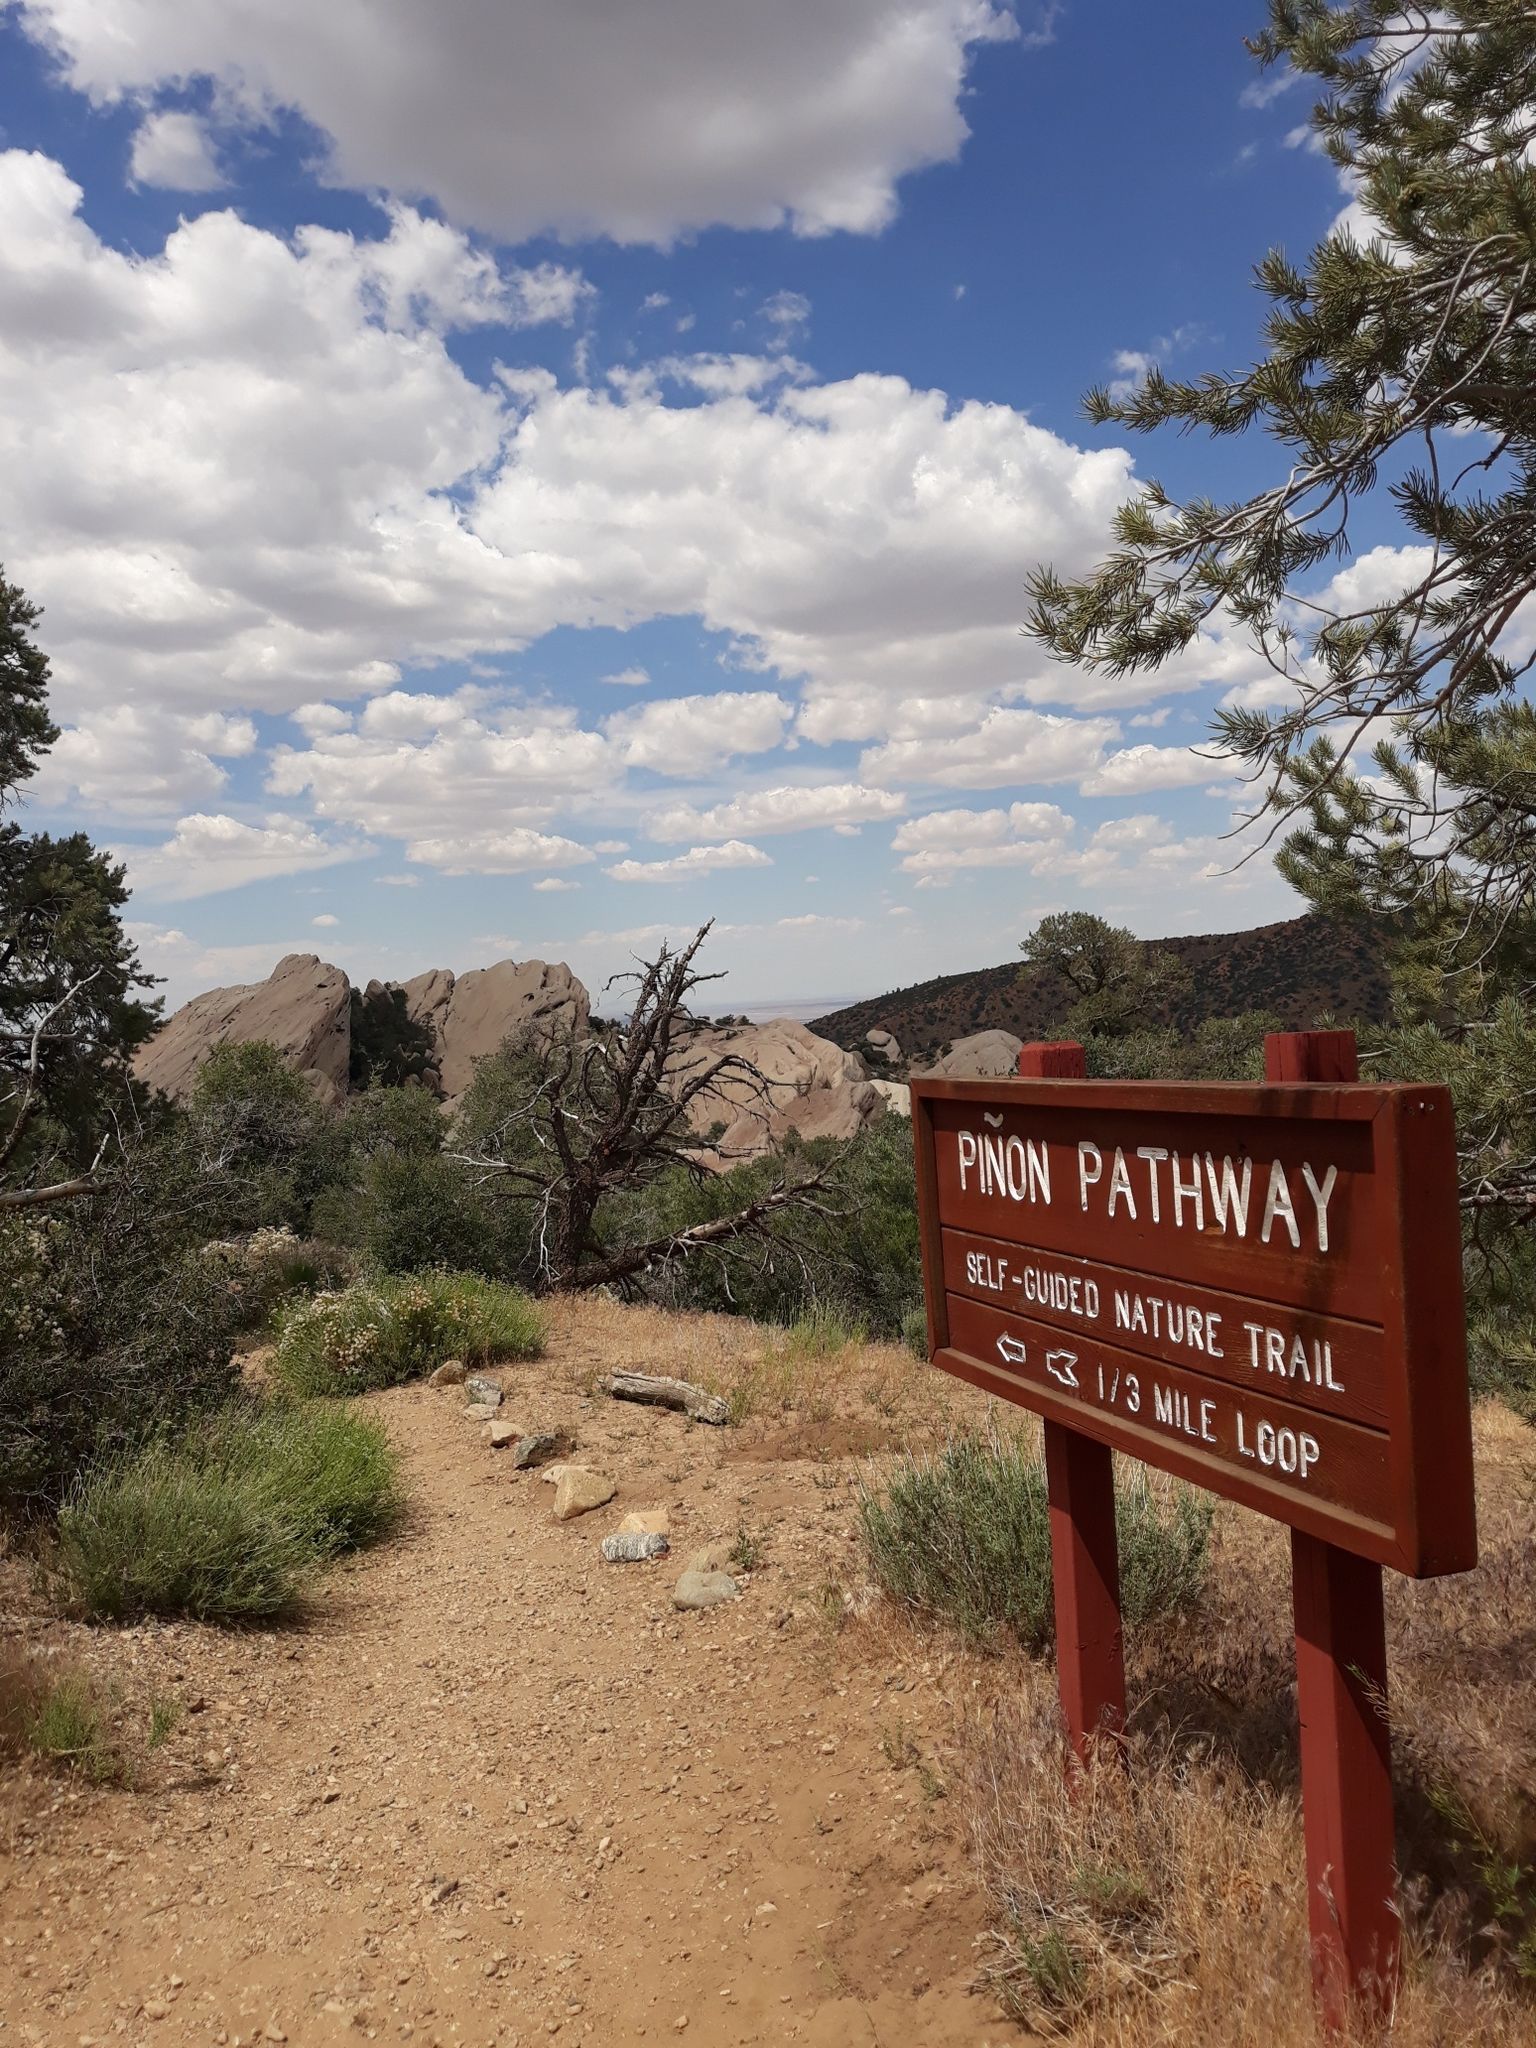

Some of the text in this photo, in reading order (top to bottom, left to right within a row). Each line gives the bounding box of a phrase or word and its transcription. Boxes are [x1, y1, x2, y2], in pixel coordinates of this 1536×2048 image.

[957, 1112, 1338, 1251] PIÑON PATHWAY
[967, 1251, 1345, 1392] SELF-GUIDED NATURE TRAIL
[1097, 1363, 1320, 1478] 1/3 MILE LOOP
